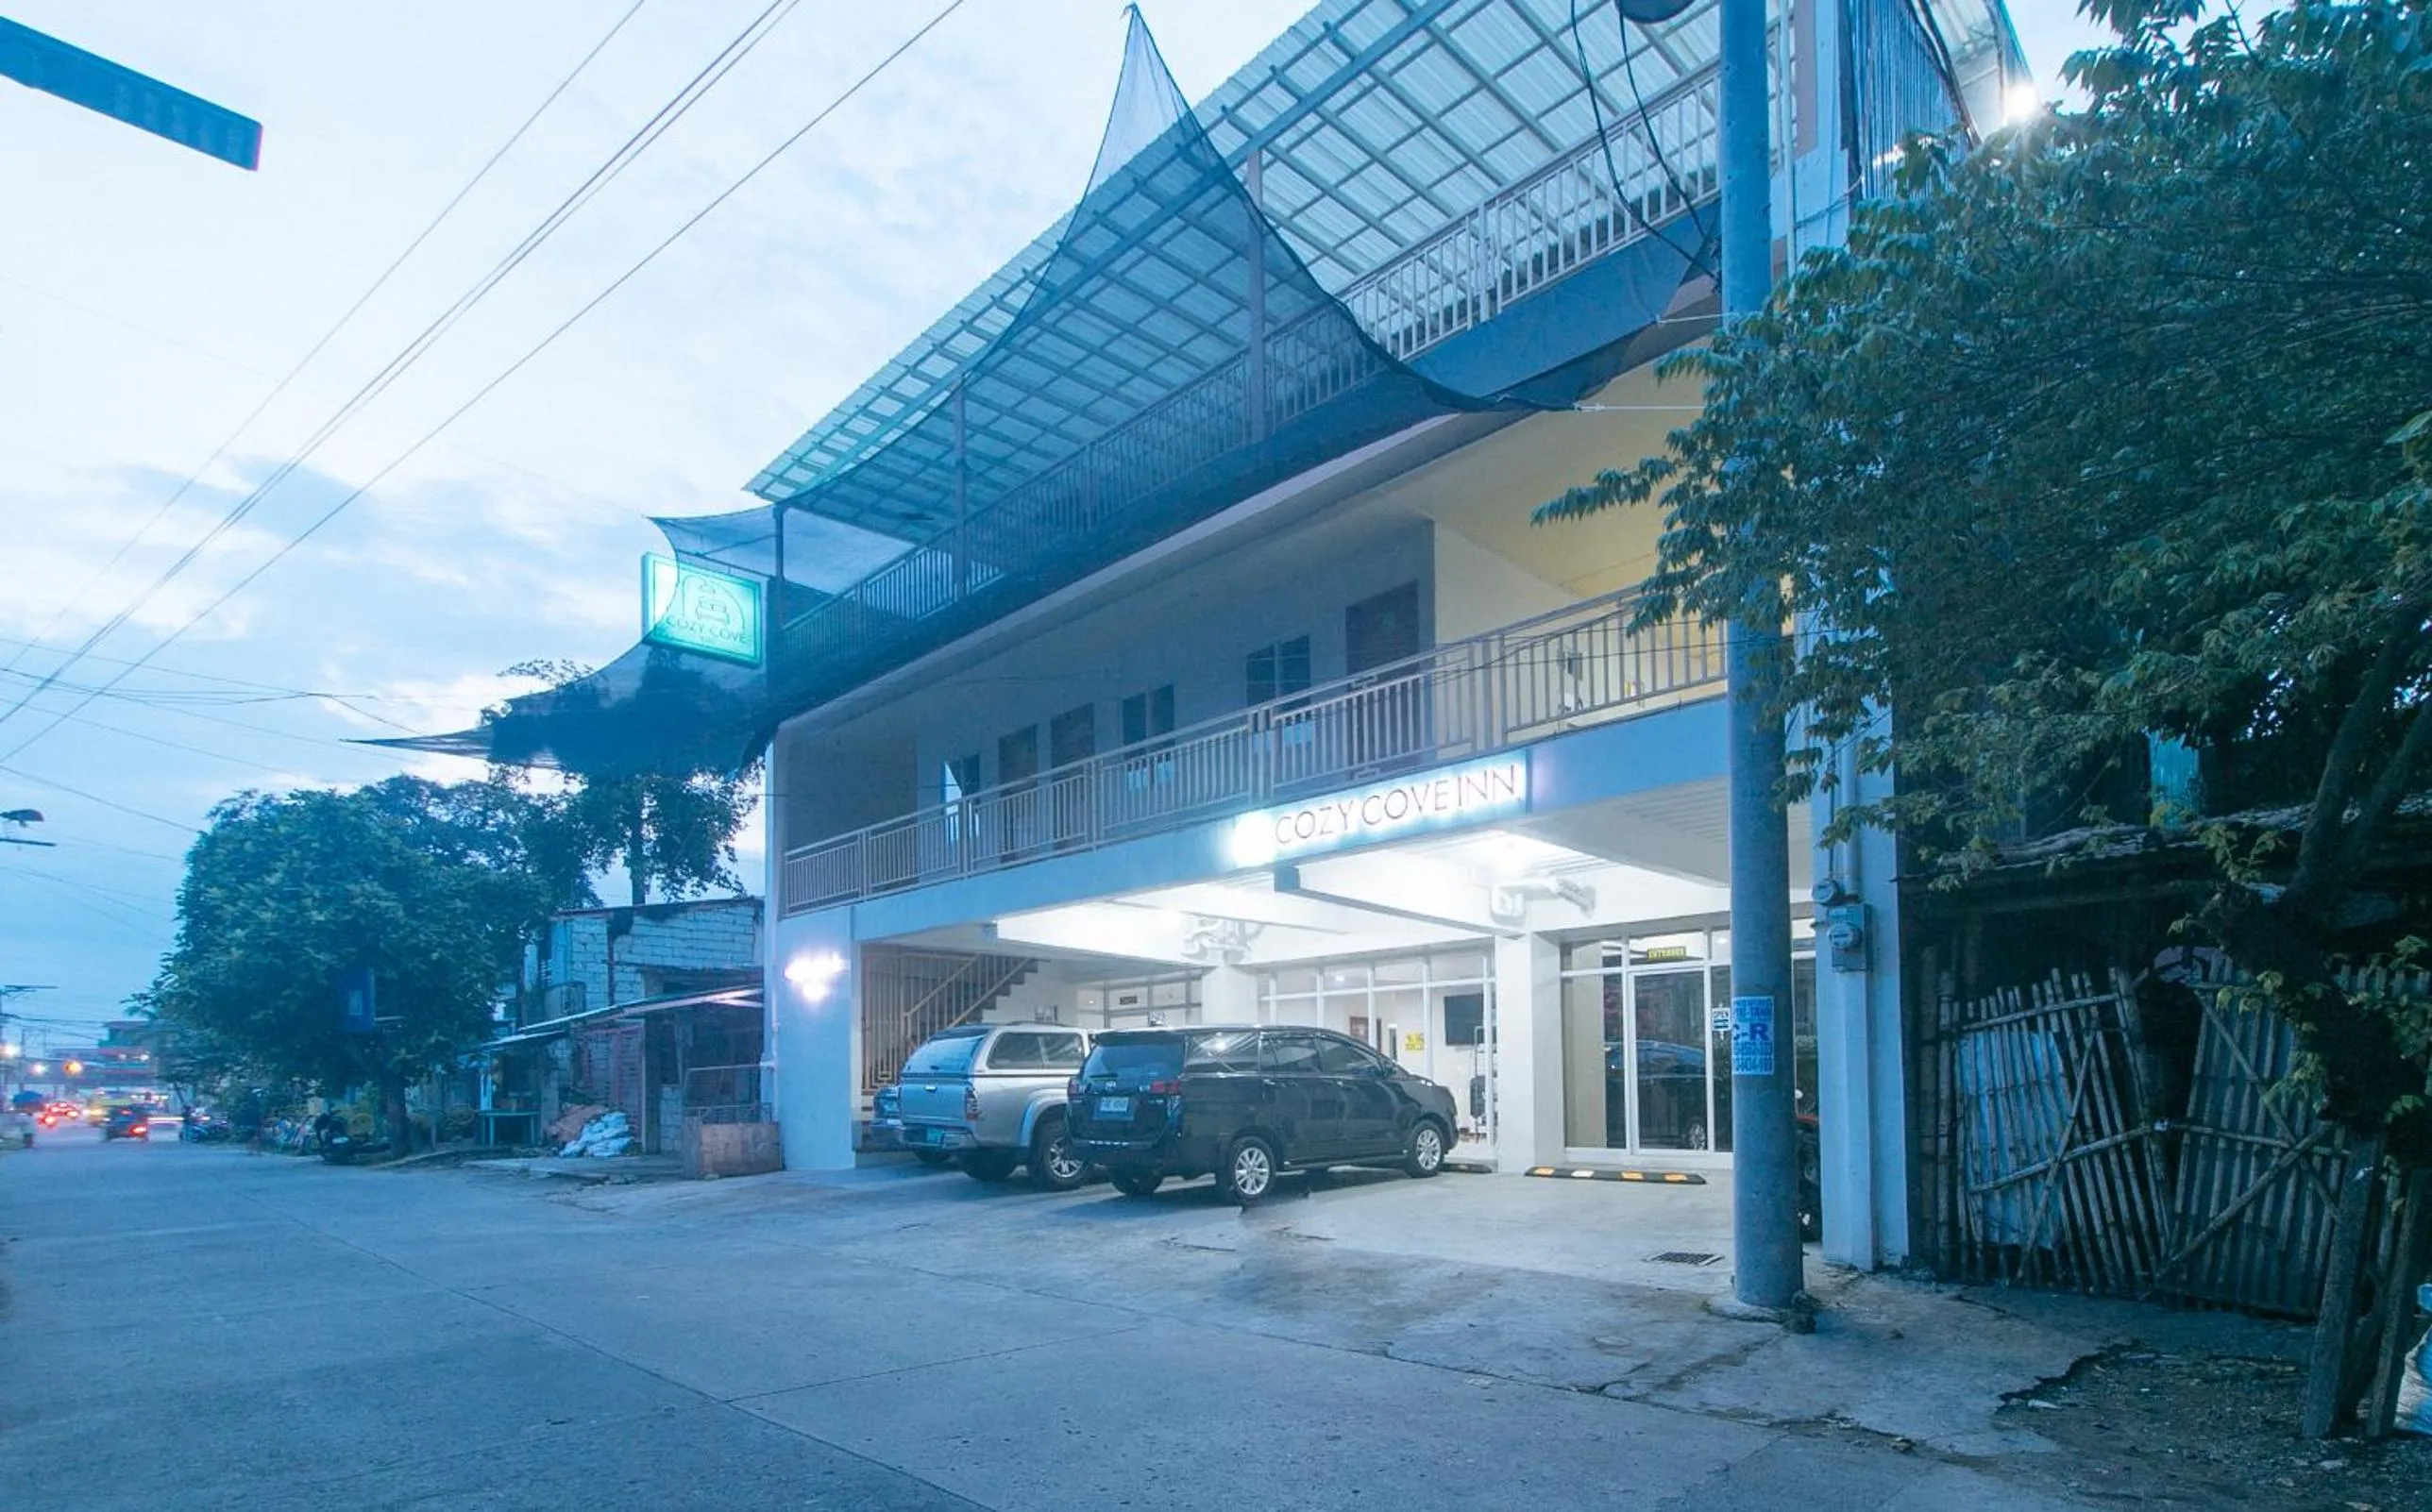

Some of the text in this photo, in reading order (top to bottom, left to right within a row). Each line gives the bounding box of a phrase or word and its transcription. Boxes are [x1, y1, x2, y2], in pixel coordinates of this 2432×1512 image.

[666, 614, 749, 644] COZY COVE
[1275, 764, 1516, 846] COZY COVE INN
